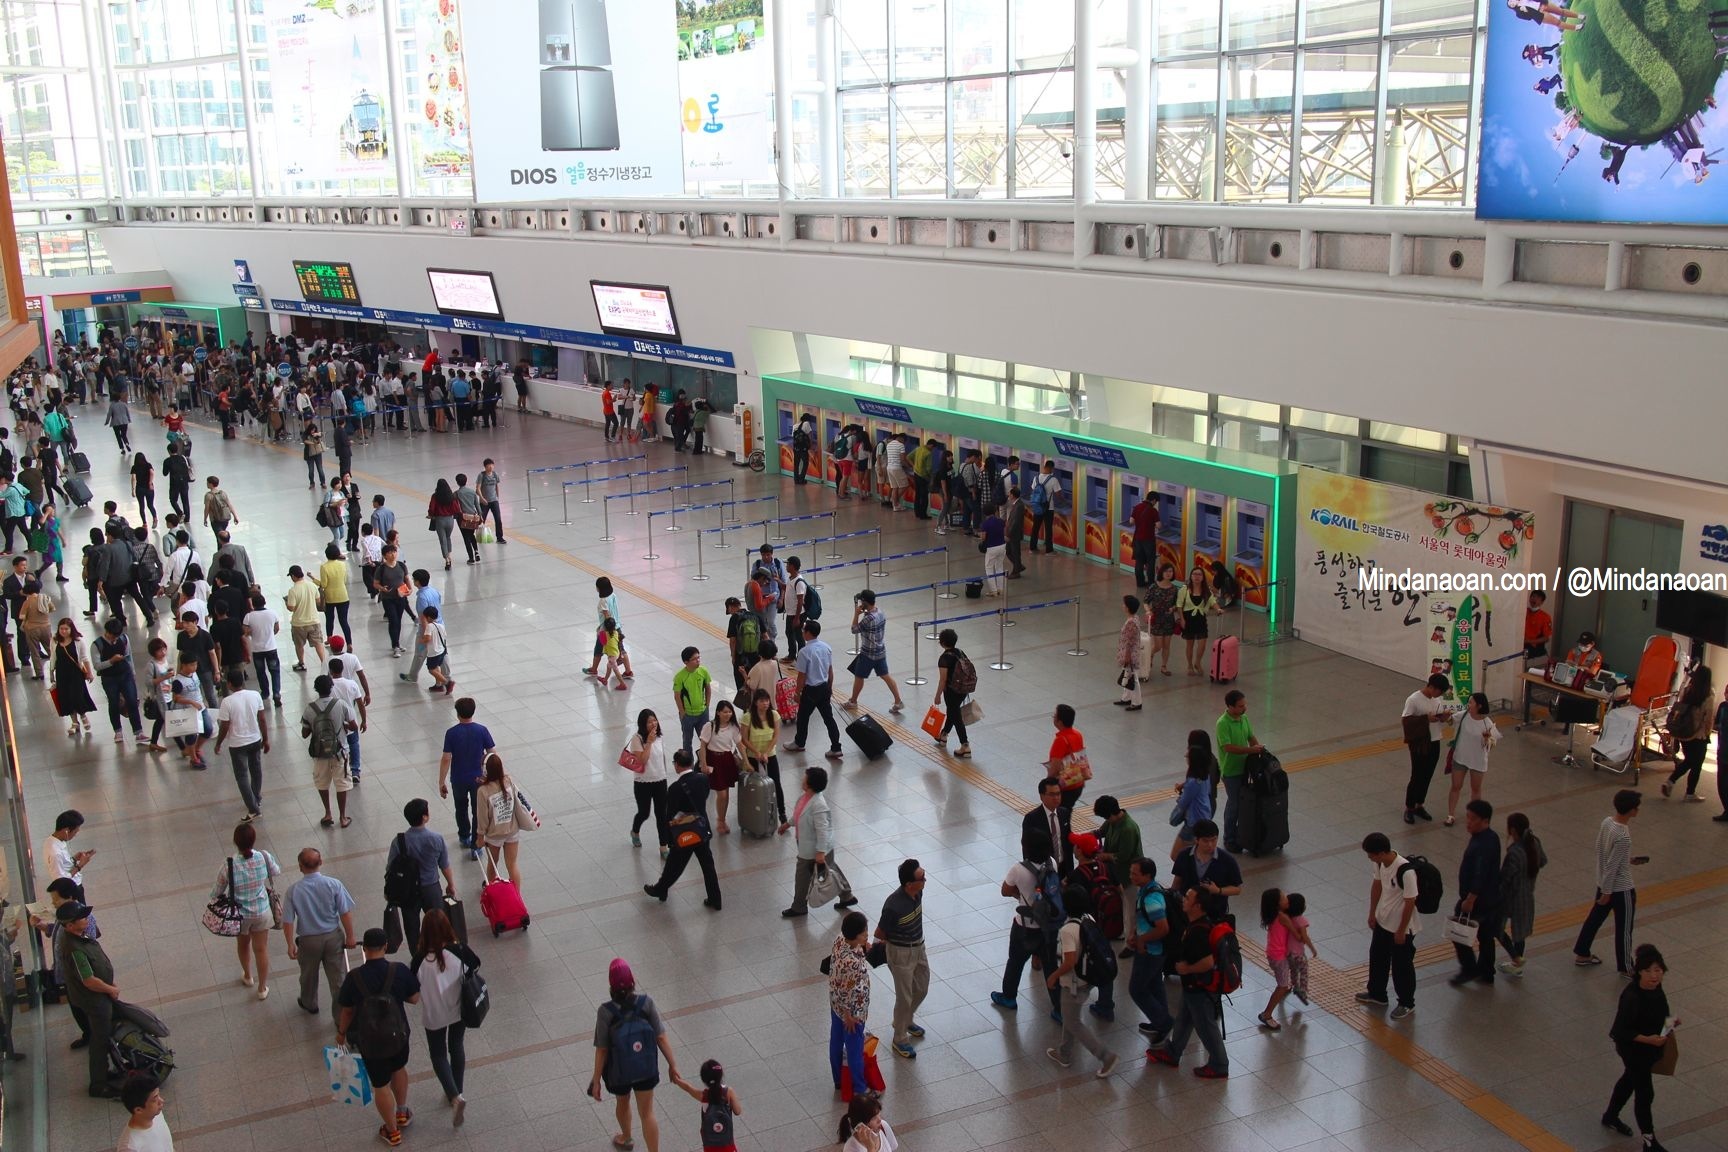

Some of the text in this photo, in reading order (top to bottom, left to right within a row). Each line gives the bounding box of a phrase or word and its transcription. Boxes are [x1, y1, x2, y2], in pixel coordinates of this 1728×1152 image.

[292, 14, 306, 24] DMZ
[510, 167, 558, 185] DIOS
[1310, 508, 1410, 543] KORAIL 한국철도공사
[1418, 536, 1508, 570] 서울역 롯데아울렛
[1333, 582, 1383, 612] 즐거운
